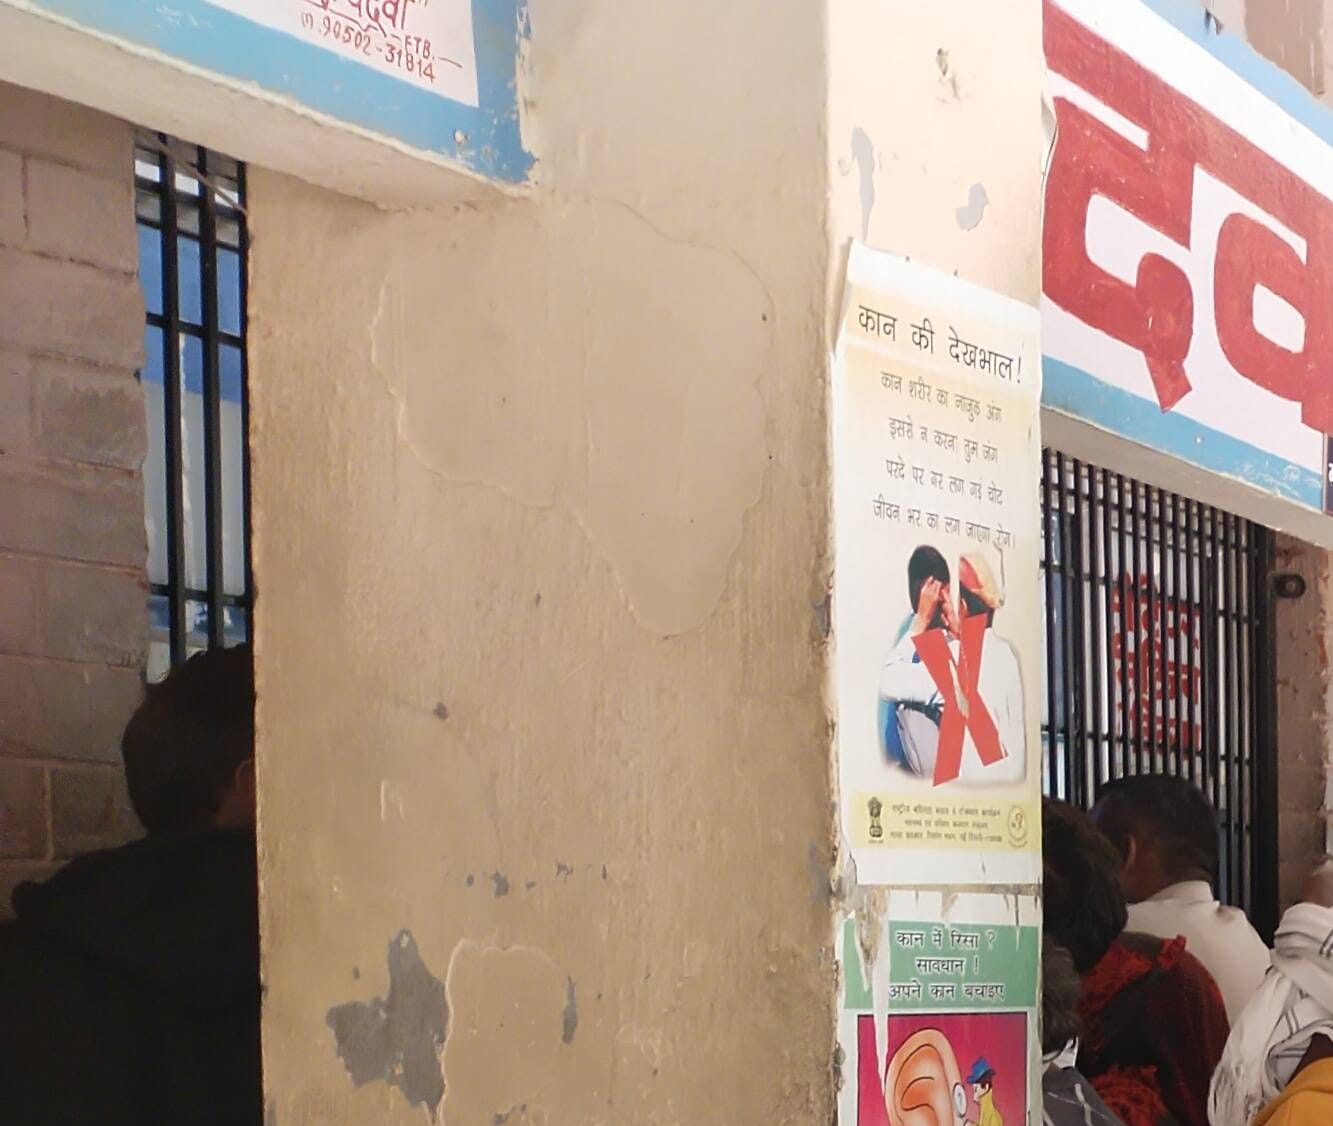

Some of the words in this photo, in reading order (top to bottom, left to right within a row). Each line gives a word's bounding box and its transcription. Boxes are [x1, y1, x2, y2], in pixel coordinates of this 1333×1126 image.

[858, 304, 897, 342] कान
[911, 317, 934, 354] की
[880, 371, 902, 393] कान
[909, 376, 931, 402] शरीर
[936, 388, 949, 408] का
[889, 414, 913, 440] इससे
[920, 426, 928, 443] न
[964, 439, 978, 463] तुम
[886, 456, 905, 480] परदे
[912, 466, 925, 486] पर
[872, 493, 900, 522] जीवन
[907, 508, 921, 528] भर
[896, 931, 924, 947] कान
[932, 928, 942, 947] में
[951, 929, 978, 948] रिसा
[915, 958, 965, 973] सावधान
[889, 979, 921, 998] अपने
[930, 984, 955, 998] कान
[964, 984, 1005, 1000] बचाइए
